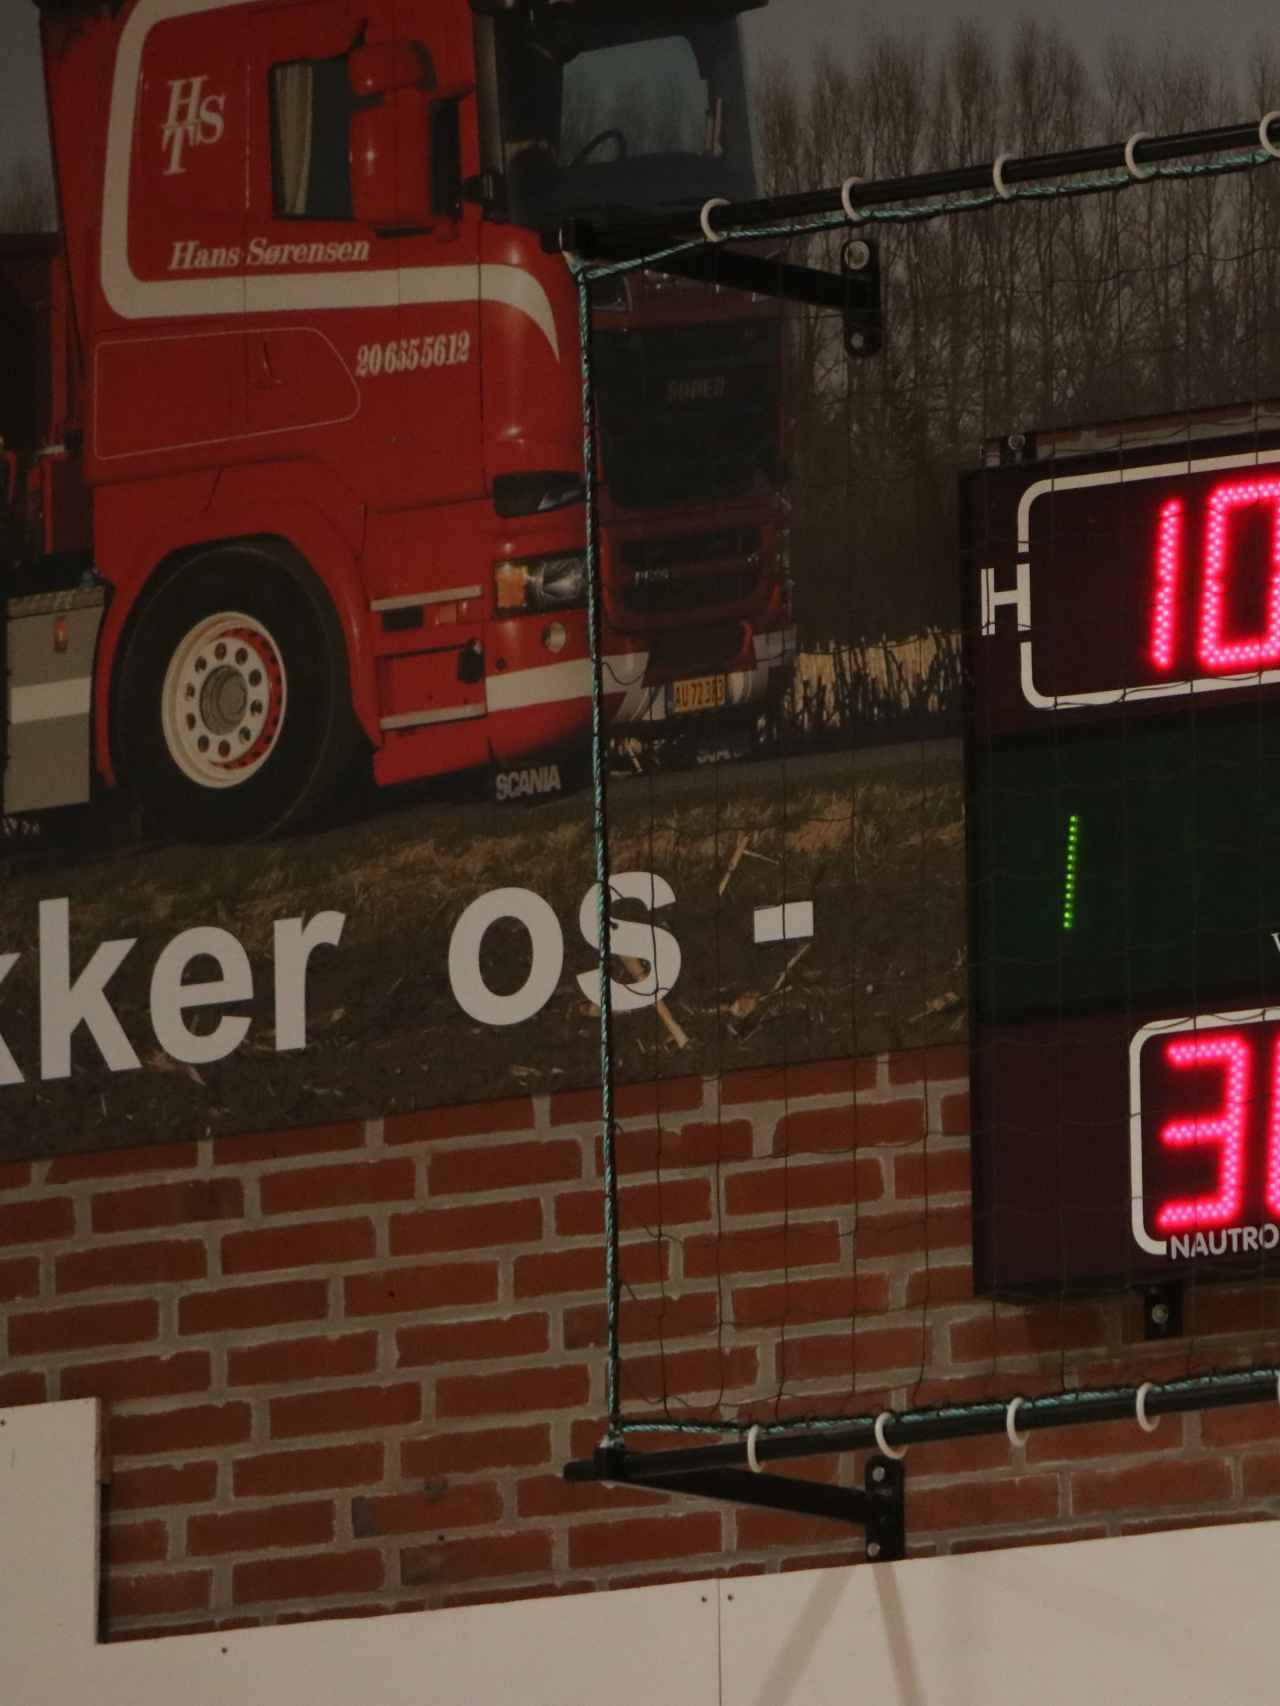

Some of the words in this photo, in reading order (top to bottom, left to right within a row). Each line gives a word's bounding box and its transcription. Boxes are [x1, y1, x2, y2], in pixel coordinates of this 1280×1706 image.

[167, 240, 241, 271] Hans
[246, 237, 370, 266] Sørensen
[981, 563, 1031, 635] H
[496, 764, 562, 800] SCANIA
[448, 871, 682, 1027] os
